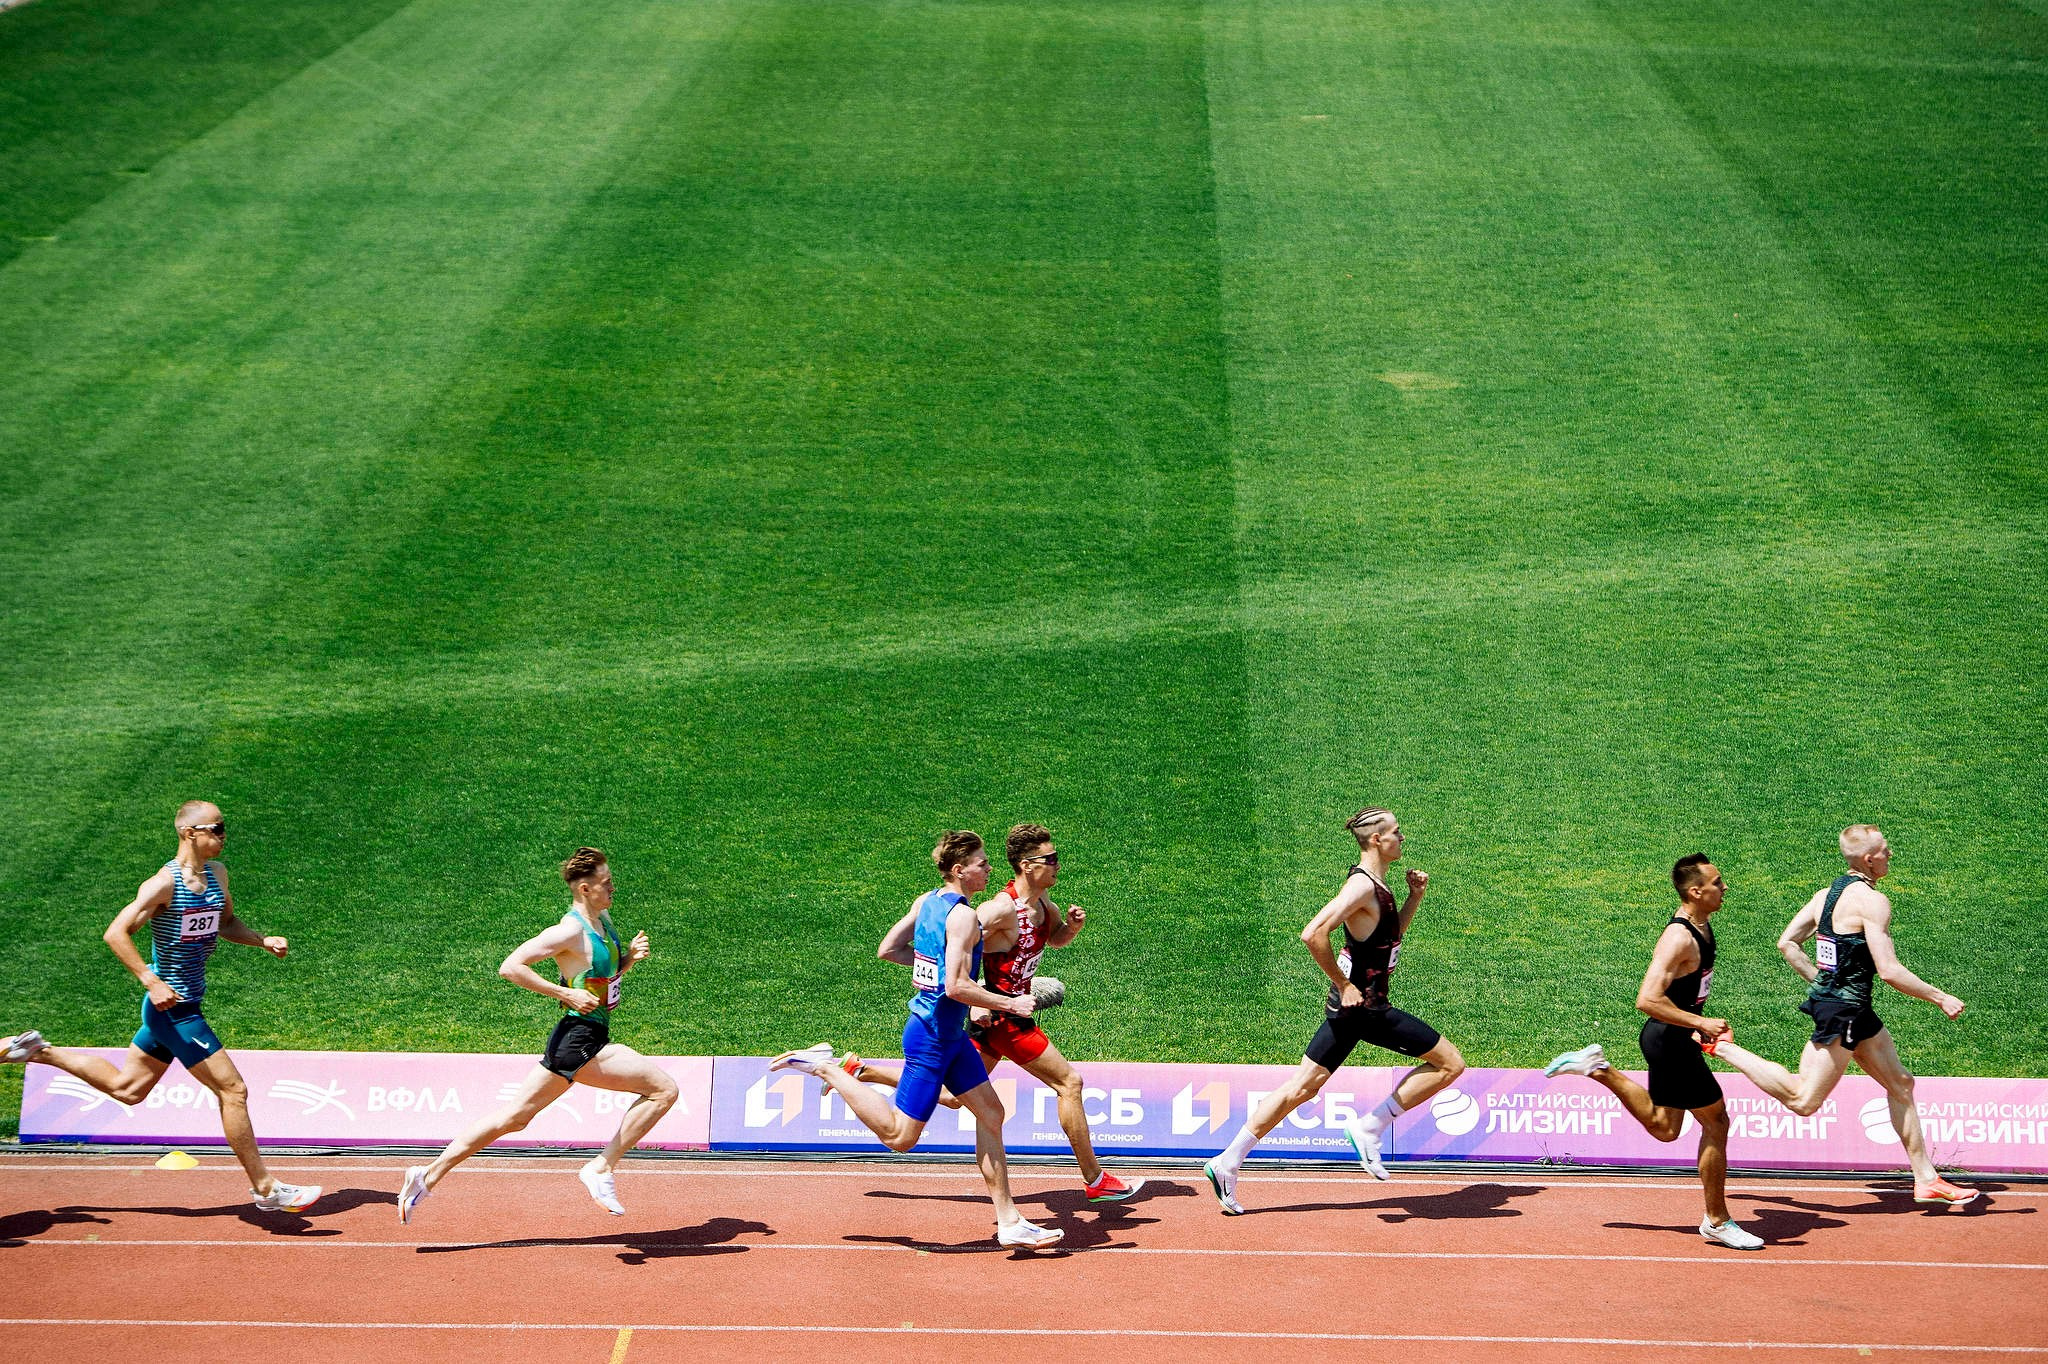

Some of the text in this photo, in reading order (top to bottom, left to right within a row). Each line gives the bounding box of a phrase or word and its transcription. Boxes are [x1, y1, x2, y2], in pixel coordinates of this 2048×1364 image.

[188, 916, 214, 931] 287
[146, 1083, 220, 1109] ВФЛ
[367, 1086, 464, 1113] ВФЛА
[1032, 1087, 1144, 1126] ПСБ
[1486, 1093, 1622, 1110] БАЛТИЙСКИЙ
[1725, 1098, 1838, 1115] ЛТИЙЙ
[1485, 1109, 1622, 1135] ЛИЗИНГ
[1727, 1114, 1838, 1140] ИЗИНГ
[1920, 1118, 2048, 1145] ЛИЗИНГ
[818, 1128, 877, 1138] ГЕНЕРАЛЬНЫ
[1032, 1132, 1144, 1143] ГЕНЕРАЛЙ СПОНСОР
[1257, 1135, 1352, 1147] НЕРАЛЬНЫЙ СПОНСО
